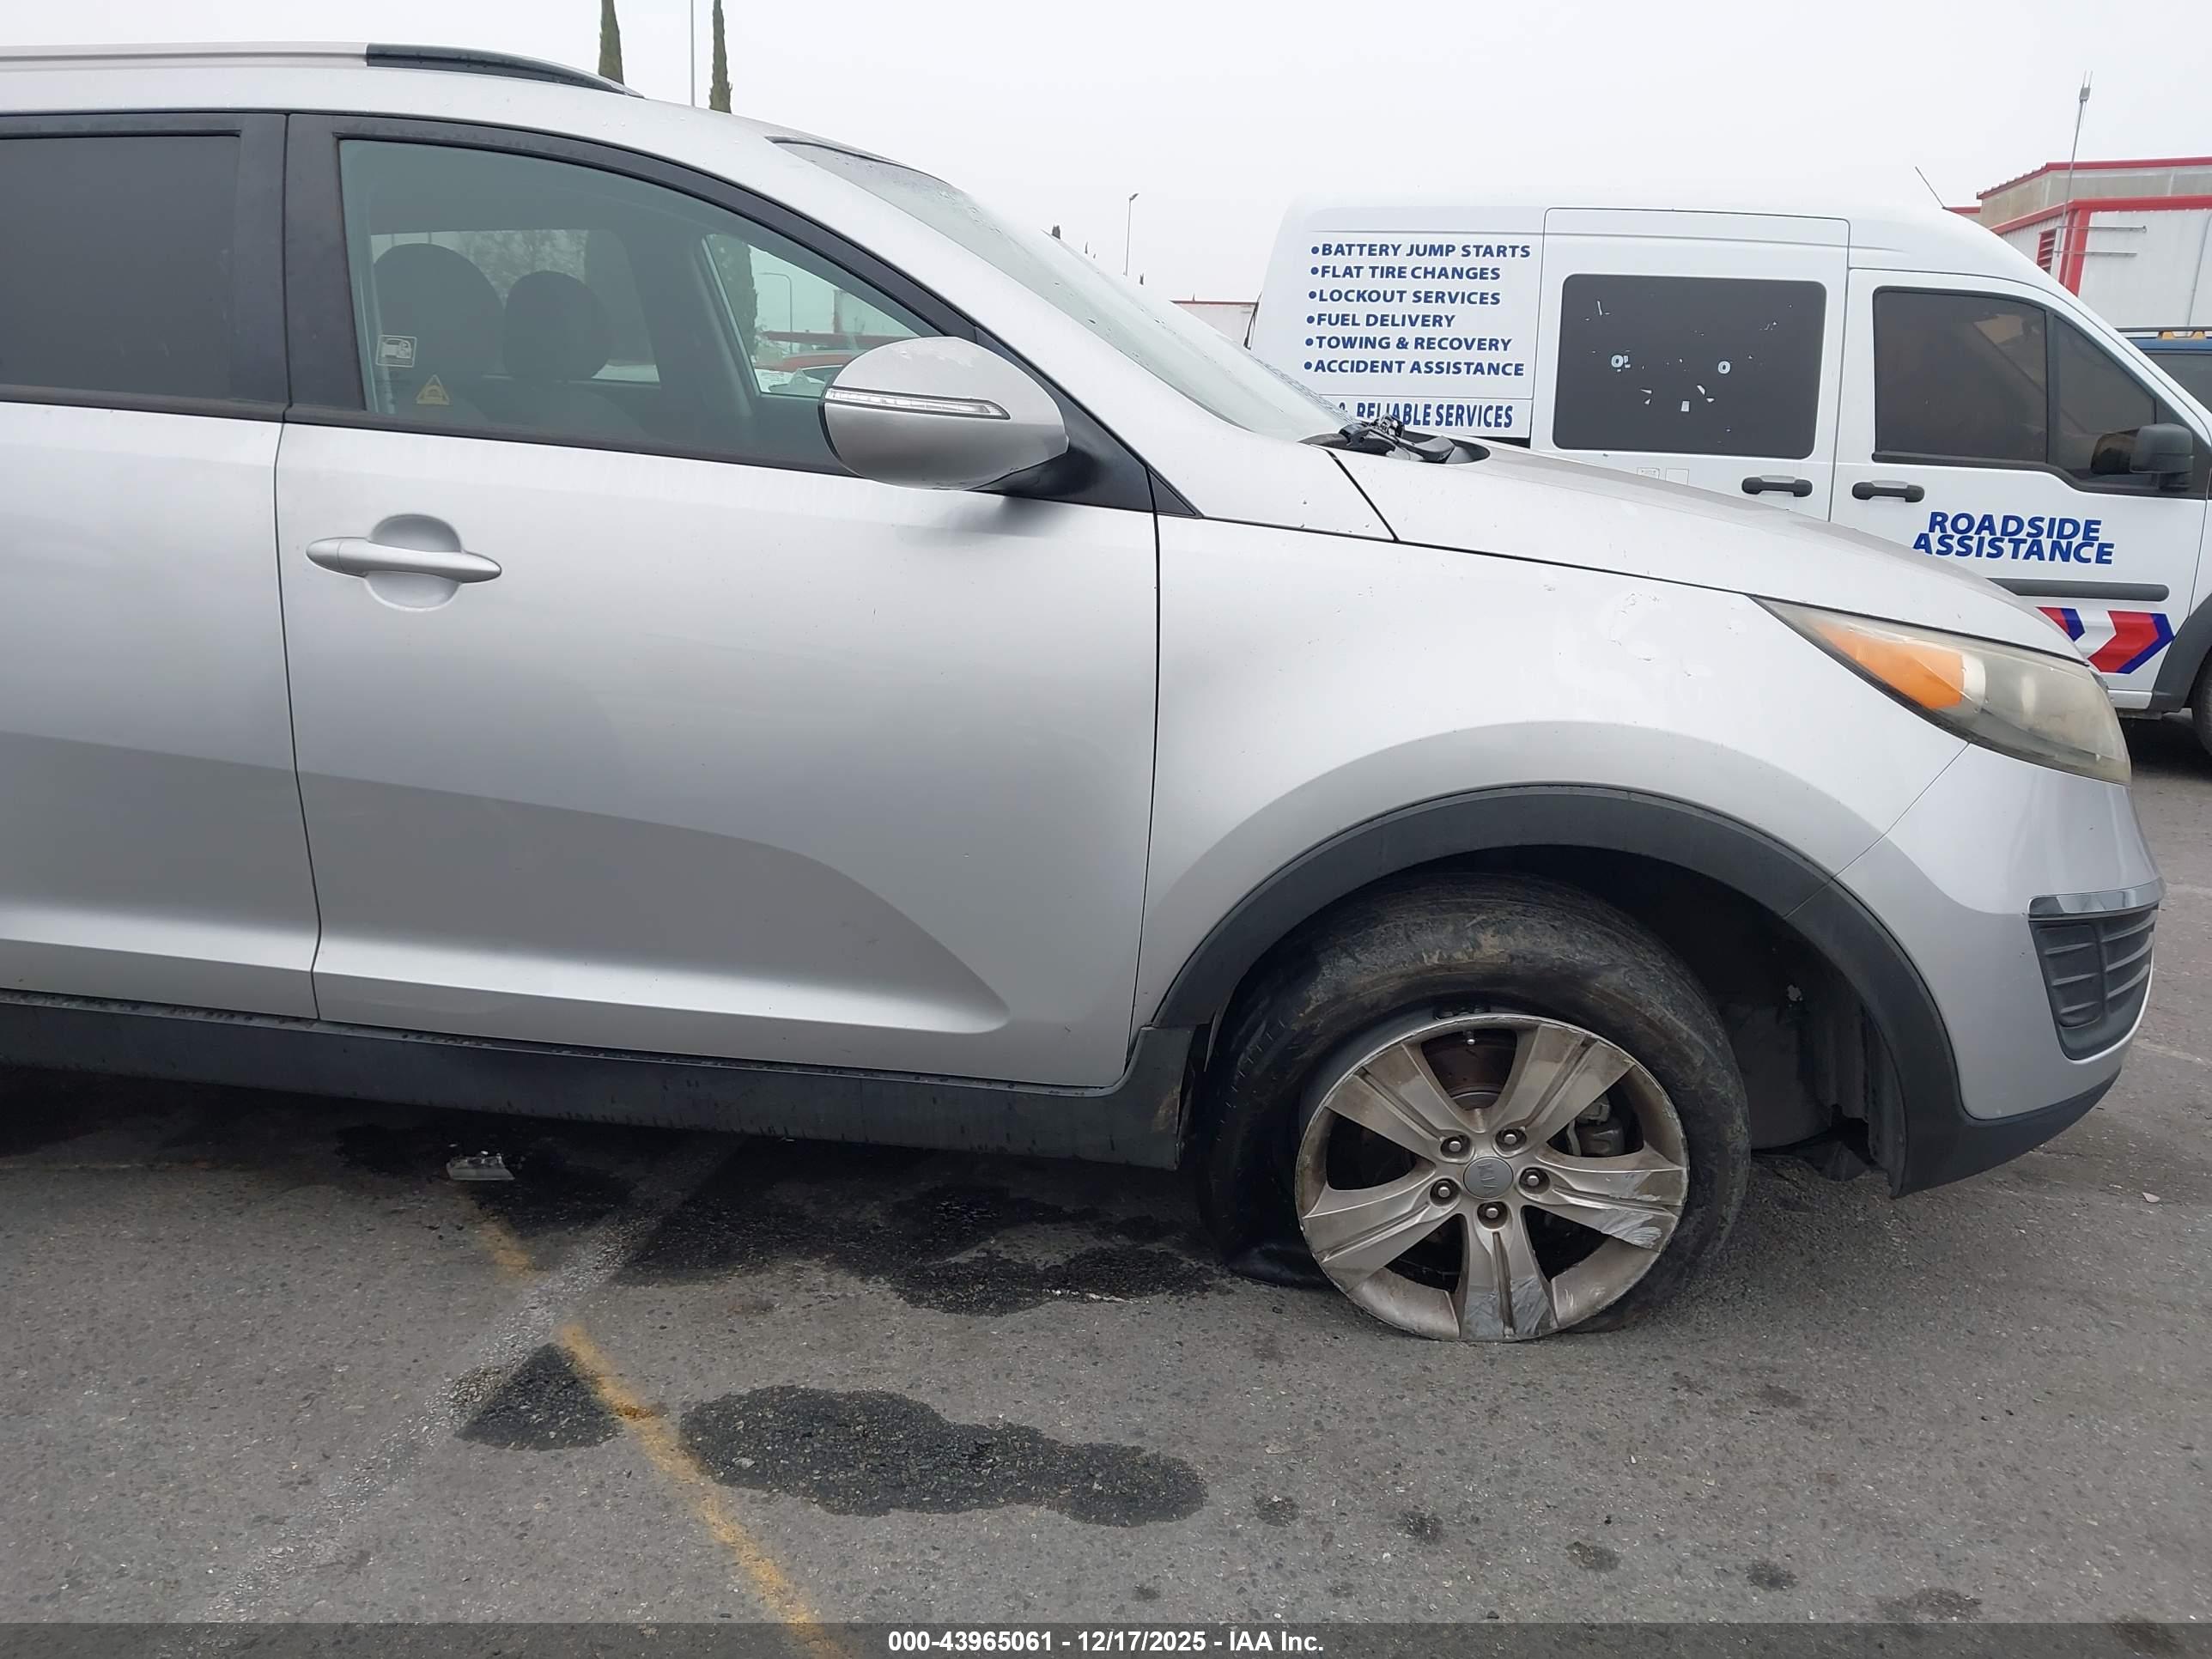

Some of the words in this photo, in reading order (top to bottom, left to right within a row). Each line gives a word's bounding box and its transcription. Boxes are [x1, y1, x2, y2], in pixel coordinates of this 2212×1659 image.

[1322, 243, 1401, 257] BATTERY
[1405, 243, 1456, 257] JUMP
[1461, 244, 1531, 258] STARTS
[1321, 264, 1364, 279] FLAT
[1369, 265, 1407, 279] TIRE
[1410, 266, 1501, 281] CHANGES
[1318, 289, 1407, 303] LOCKOUT
[1412, 289, 1501, 306] SERVICES
[1317, 313, 1361, 327] FUEL
[1365, 313, 1456, 328] DELIVERY
[1316, 335, 1391, 350] TOWING
[1395, 336, 1410, 350] &
[1413, 337, 1513, 352] RECOVERY
[1314, 359, 1406, 374] ACCIDENT
[1409, 360, 1525, 377] ASSISTANCE
[1434, 404, 1514, 428] SERVICES
[1927, 511, 2103, 542] ROADSIDE
[1913, 532, 2115, 565] ASSISTANCE
